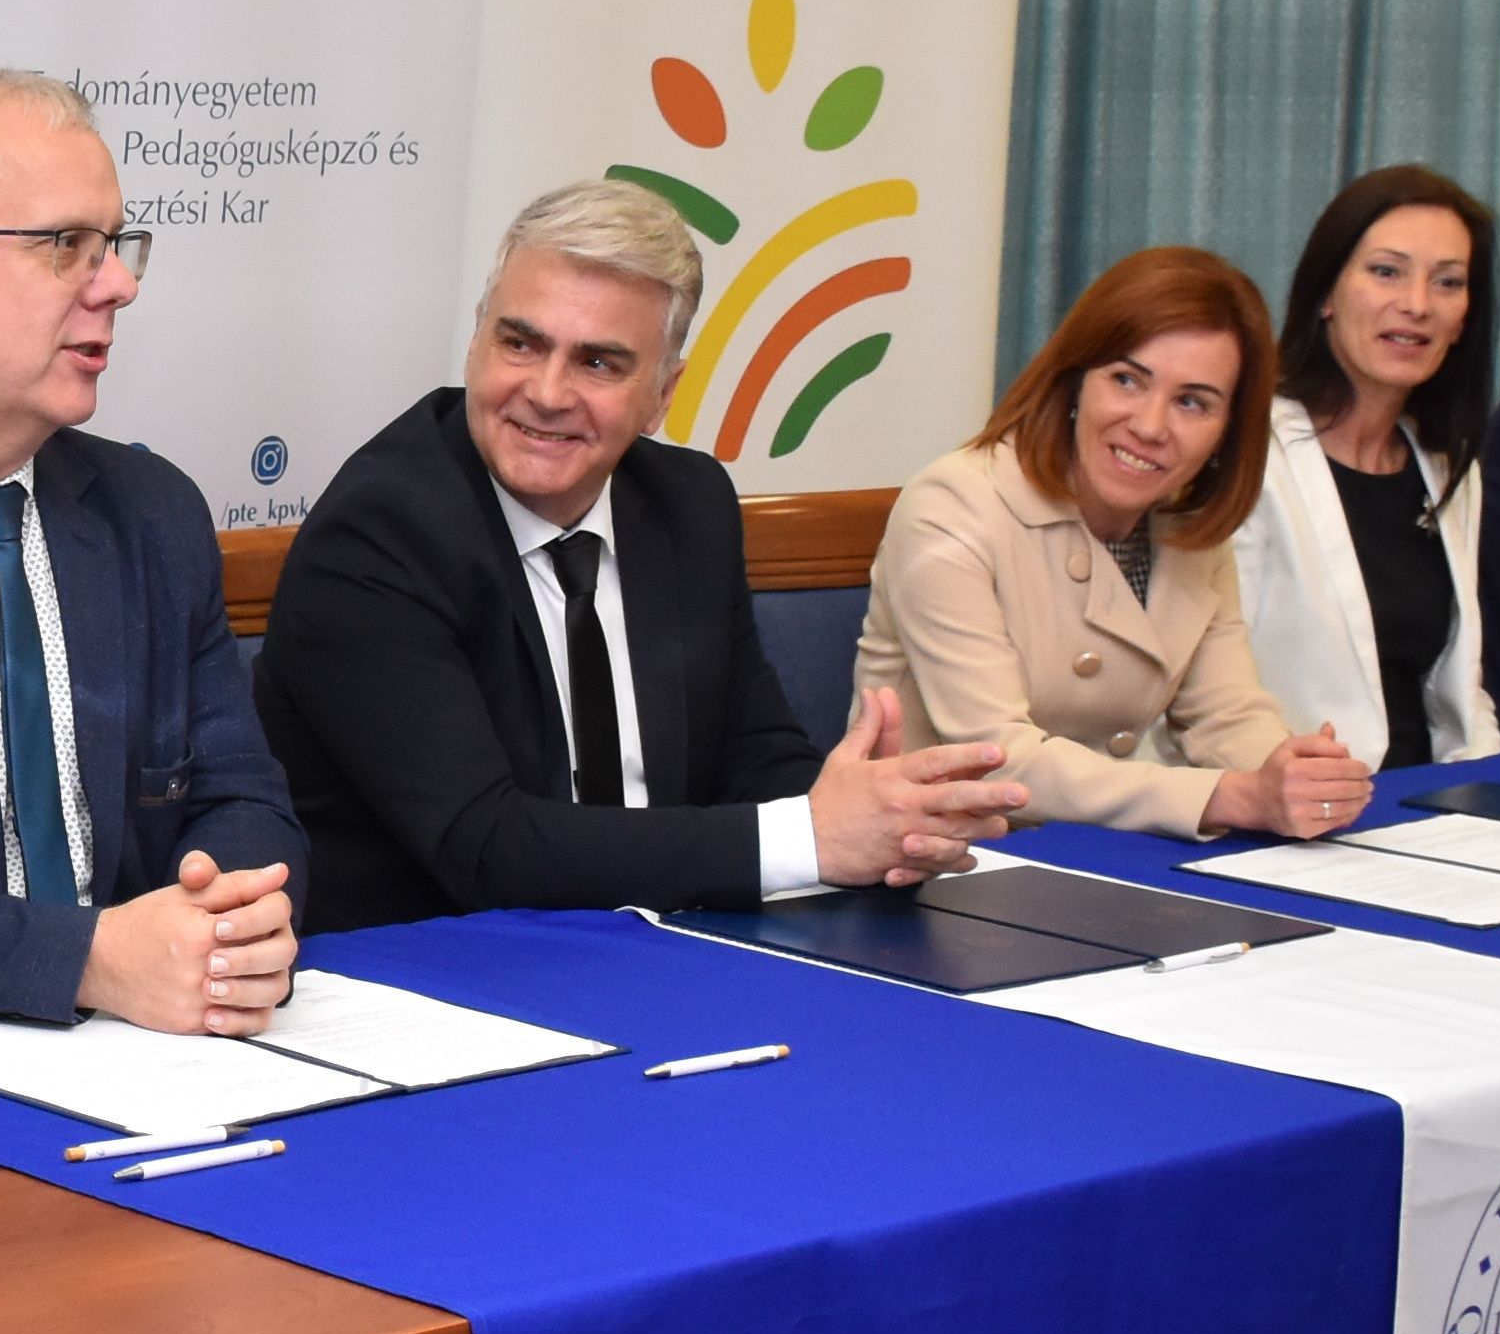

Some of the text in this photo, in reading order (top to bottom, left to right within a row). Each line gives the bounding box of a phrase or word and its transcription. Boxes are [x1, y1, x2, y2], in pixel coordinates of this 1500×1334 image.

[28, 69, 318, 120] dományegyetem
[123, 130, 420, 178] Pedagógusképző és
[124, 191, 270, 225] sztési Kar
